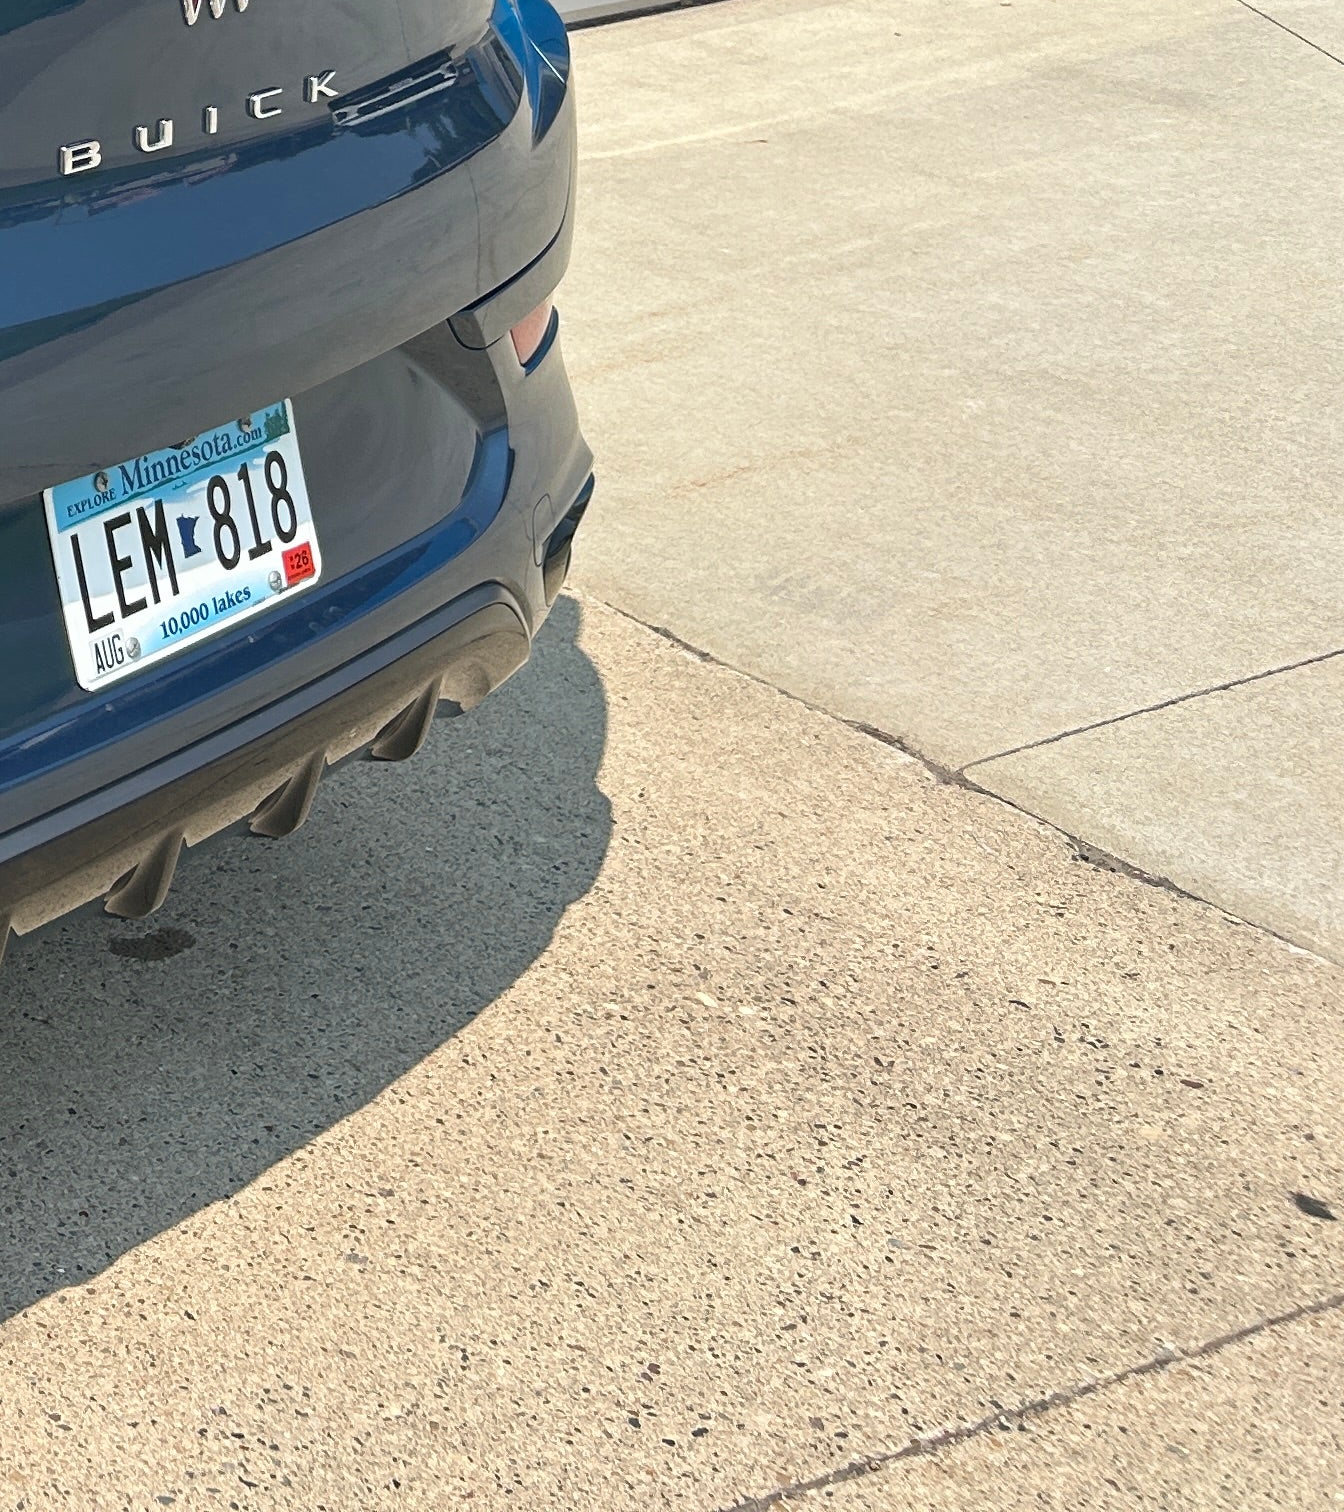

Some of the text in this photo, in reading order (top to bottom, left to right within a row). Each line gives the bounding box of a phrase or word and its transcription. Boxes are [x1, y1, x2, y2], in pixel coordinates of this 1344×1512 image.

[59, 68, 340, 176] BUICK
[66, 425, 263, 518] EXPLORE Minnesota.com
[70, 450, 298, 634] LEM 818
[293, 549, 310, 570] 26
[160, 585, 252, 639] 10,000 lakes
[92, 633, 126, 674] AUG
